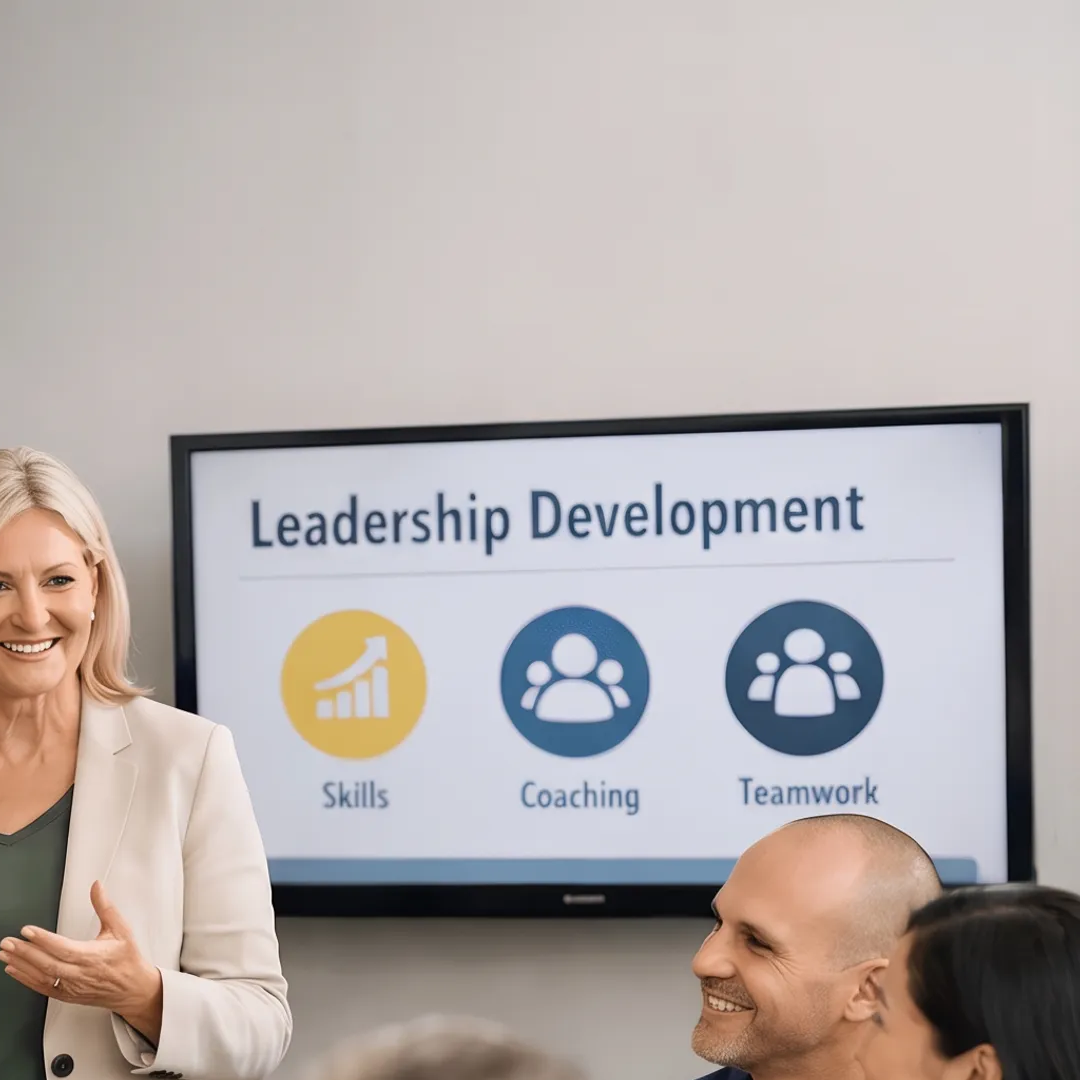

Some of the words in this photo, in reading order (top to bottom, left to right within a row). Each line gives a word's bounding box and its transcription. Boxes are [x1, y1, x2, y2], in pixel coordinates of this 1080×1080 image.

[249, 491, 511, 557] Leadership
[529, 481, 866, 551] Development
[321, 779, 390, 810] Skills
[520, 780, 640, 817] Coaching
[737, 775, 880, 807] Teamwork
